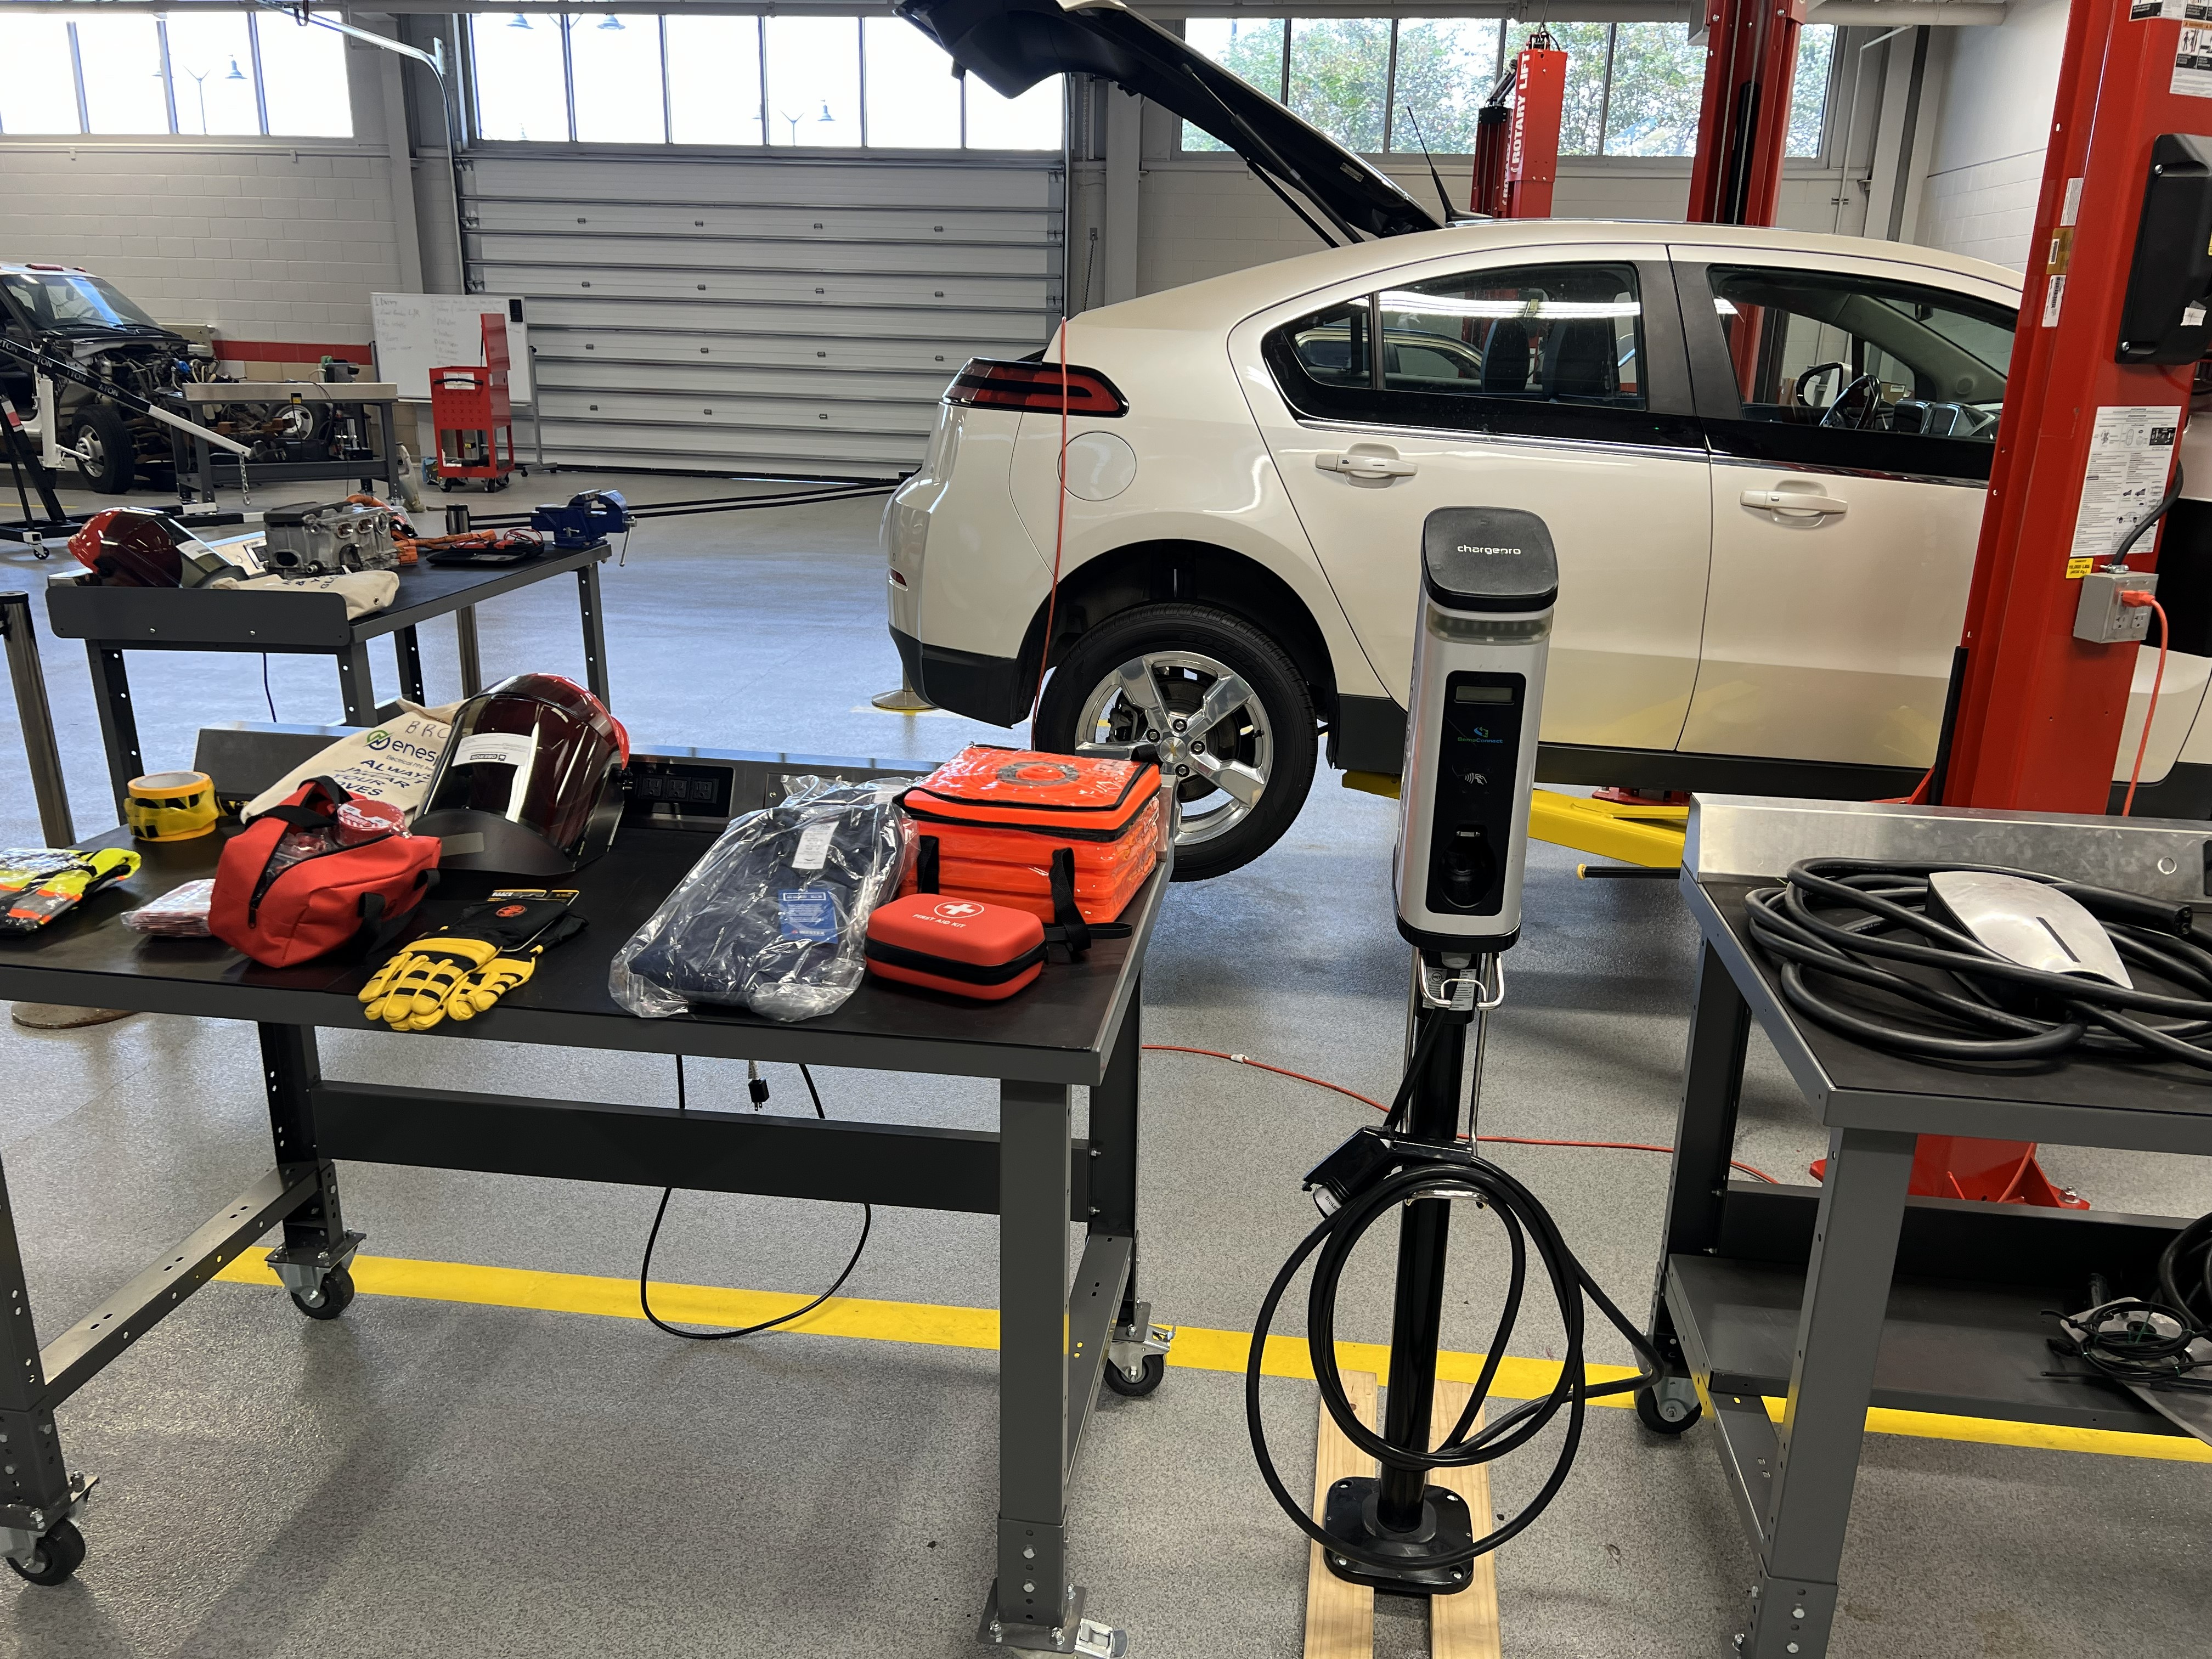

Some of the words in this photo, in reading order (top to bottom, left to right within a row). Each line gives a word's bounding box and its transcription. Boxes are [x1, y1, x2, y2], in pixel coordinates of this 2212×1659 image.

[1511, 95, 1527, 165] ROTARY
[1519, 53, 1531, 90] LIFT
[0, 340, 19, 353] TON
[334, 774, 386, 786] YOUR
